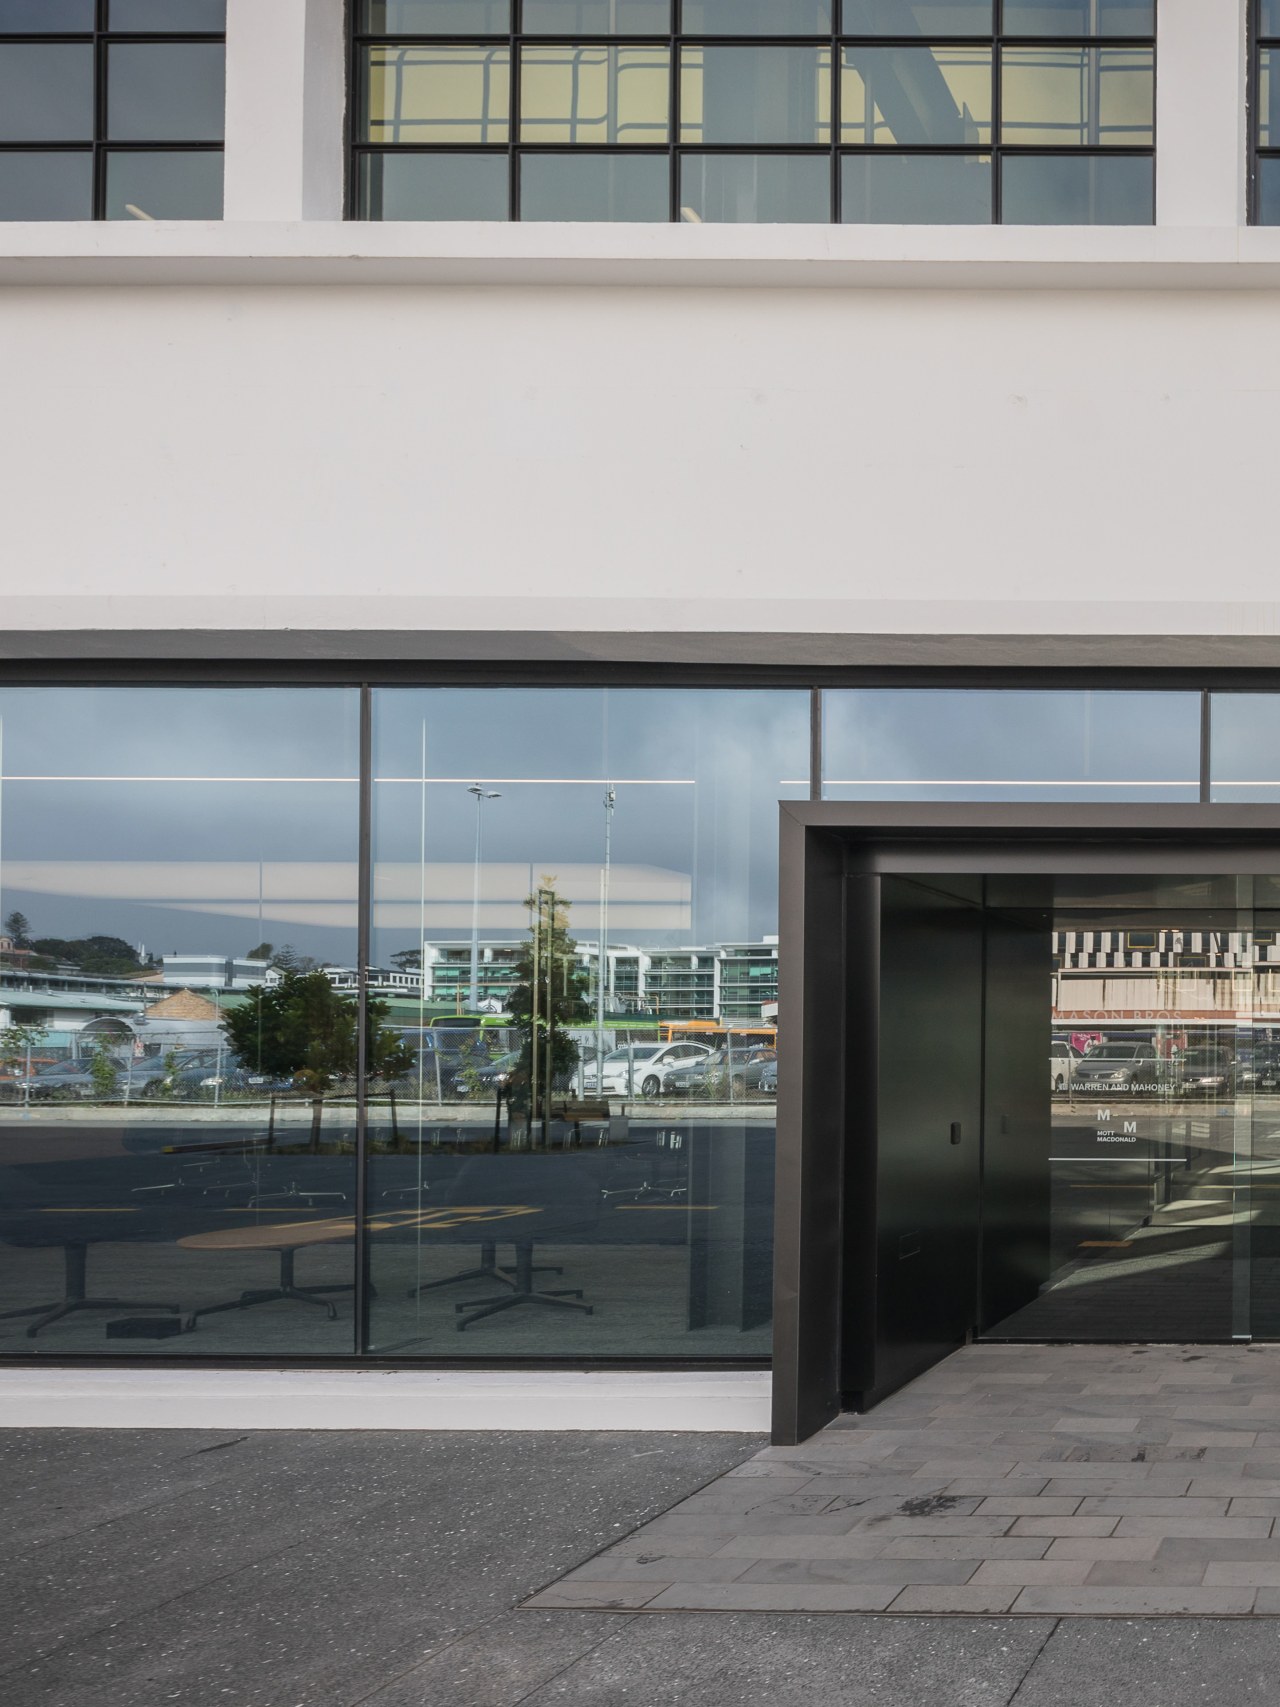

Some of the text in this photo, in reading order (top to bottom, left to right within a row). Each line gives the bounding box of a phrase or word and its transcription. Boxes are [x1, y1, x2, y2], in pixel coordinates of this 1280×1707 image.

[1052, 1010, 1124, 1020] MASON
[1071, 1083, 1176, 1091] WARREN AND MAHONEY
[1097, 1109, 1110, 1121] M
[1123, 1121, 1137, 1133] M
